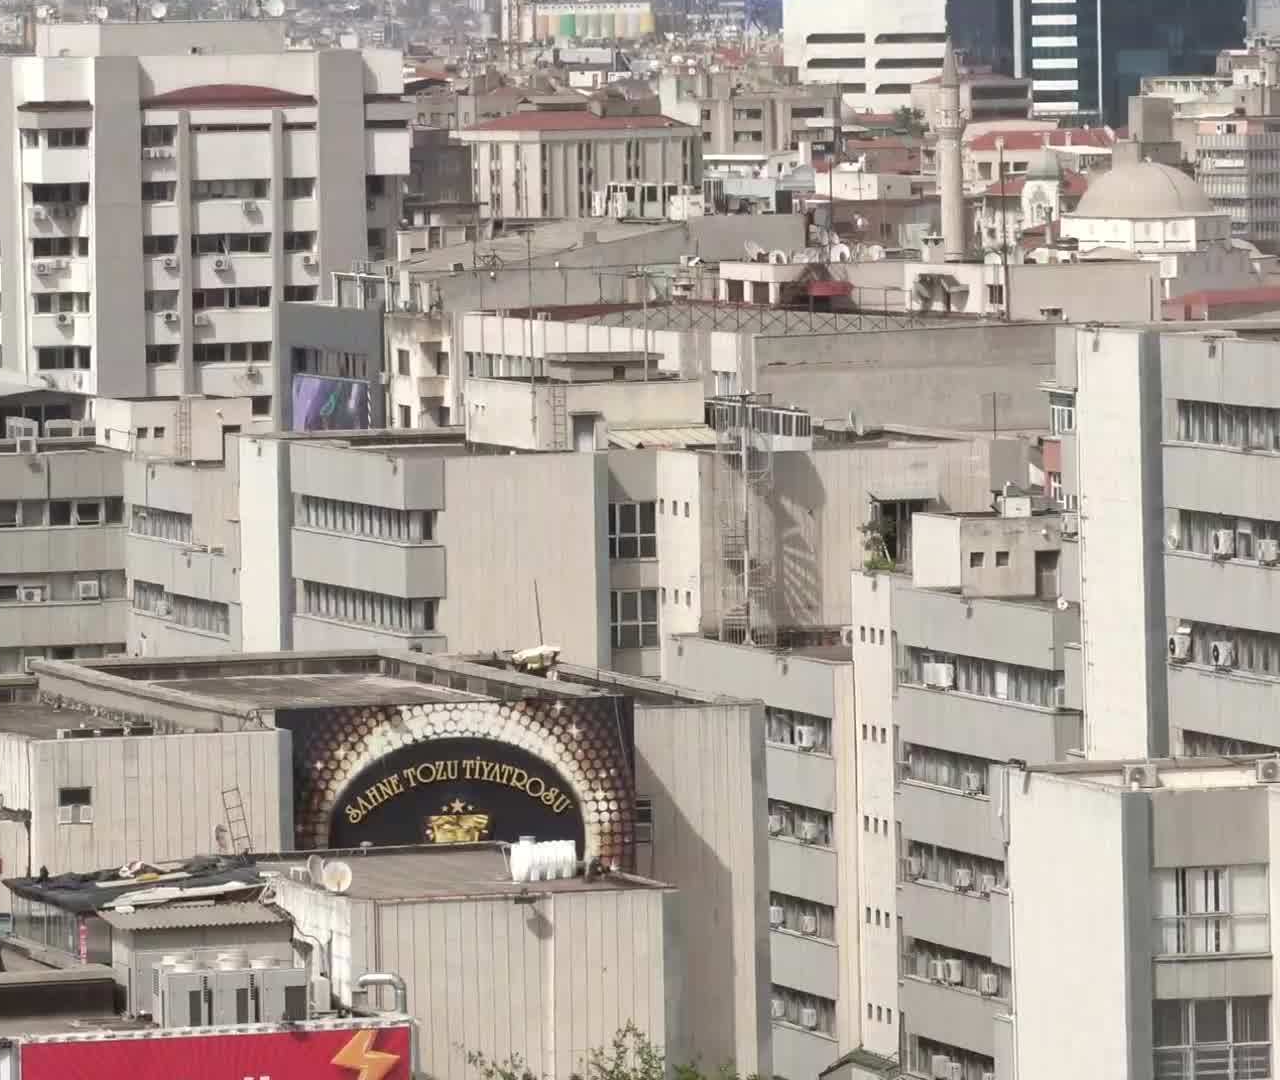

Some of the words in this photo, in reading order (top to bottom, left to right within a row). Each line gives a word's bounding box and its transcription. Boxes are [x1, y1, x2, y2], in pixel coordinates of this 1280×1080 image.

[345, 774, 404, 823] SAHNE
[403, 759, 458, 787] TOZU
[462, 756, 570, 813] TİYATROSU
